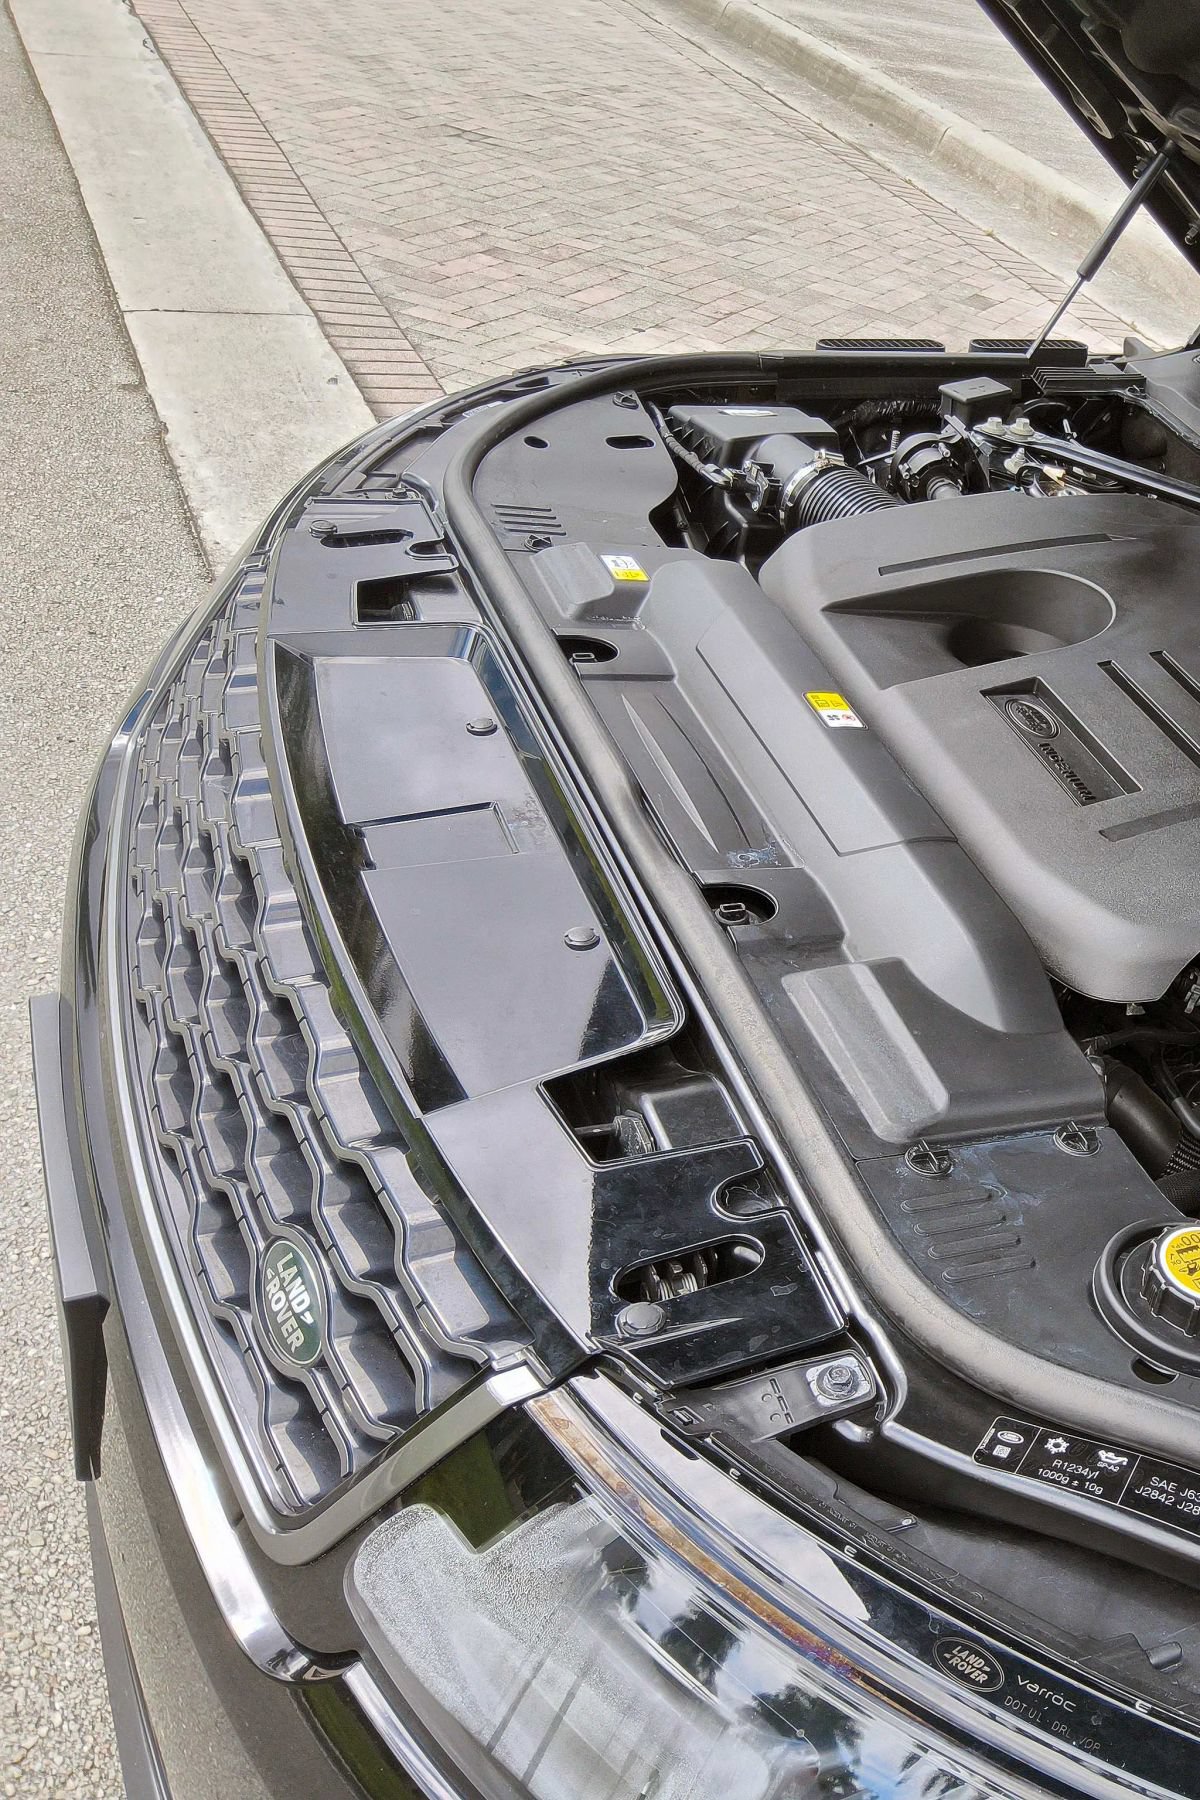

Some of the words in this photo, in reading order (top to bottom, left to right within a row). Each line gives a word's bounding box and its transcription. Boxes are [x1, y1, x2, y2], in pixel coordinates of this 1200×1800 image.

[277, 1252, 311, 1314] LAND
[266, 1276, 305, 1354] ROVER
[1037, 1468, 1070, 1485] 1000g
[1084, 1481, 1104, 1495] 10g
[1052, 1459, 1100, 1480] R1234yf
[1134, 1485, 1176, 1506] J2842
[1150, 1476, 1178, 1493] SAE
[947, 1656, 989, 1684] ROVER
[951, 1645, 985, 1669] LAND
[1017, 1674, 1077, 1713] varroc
[1004, 1695, 1028, 1713] DOT
[1051, 1720, 1072, 1739] DRL
